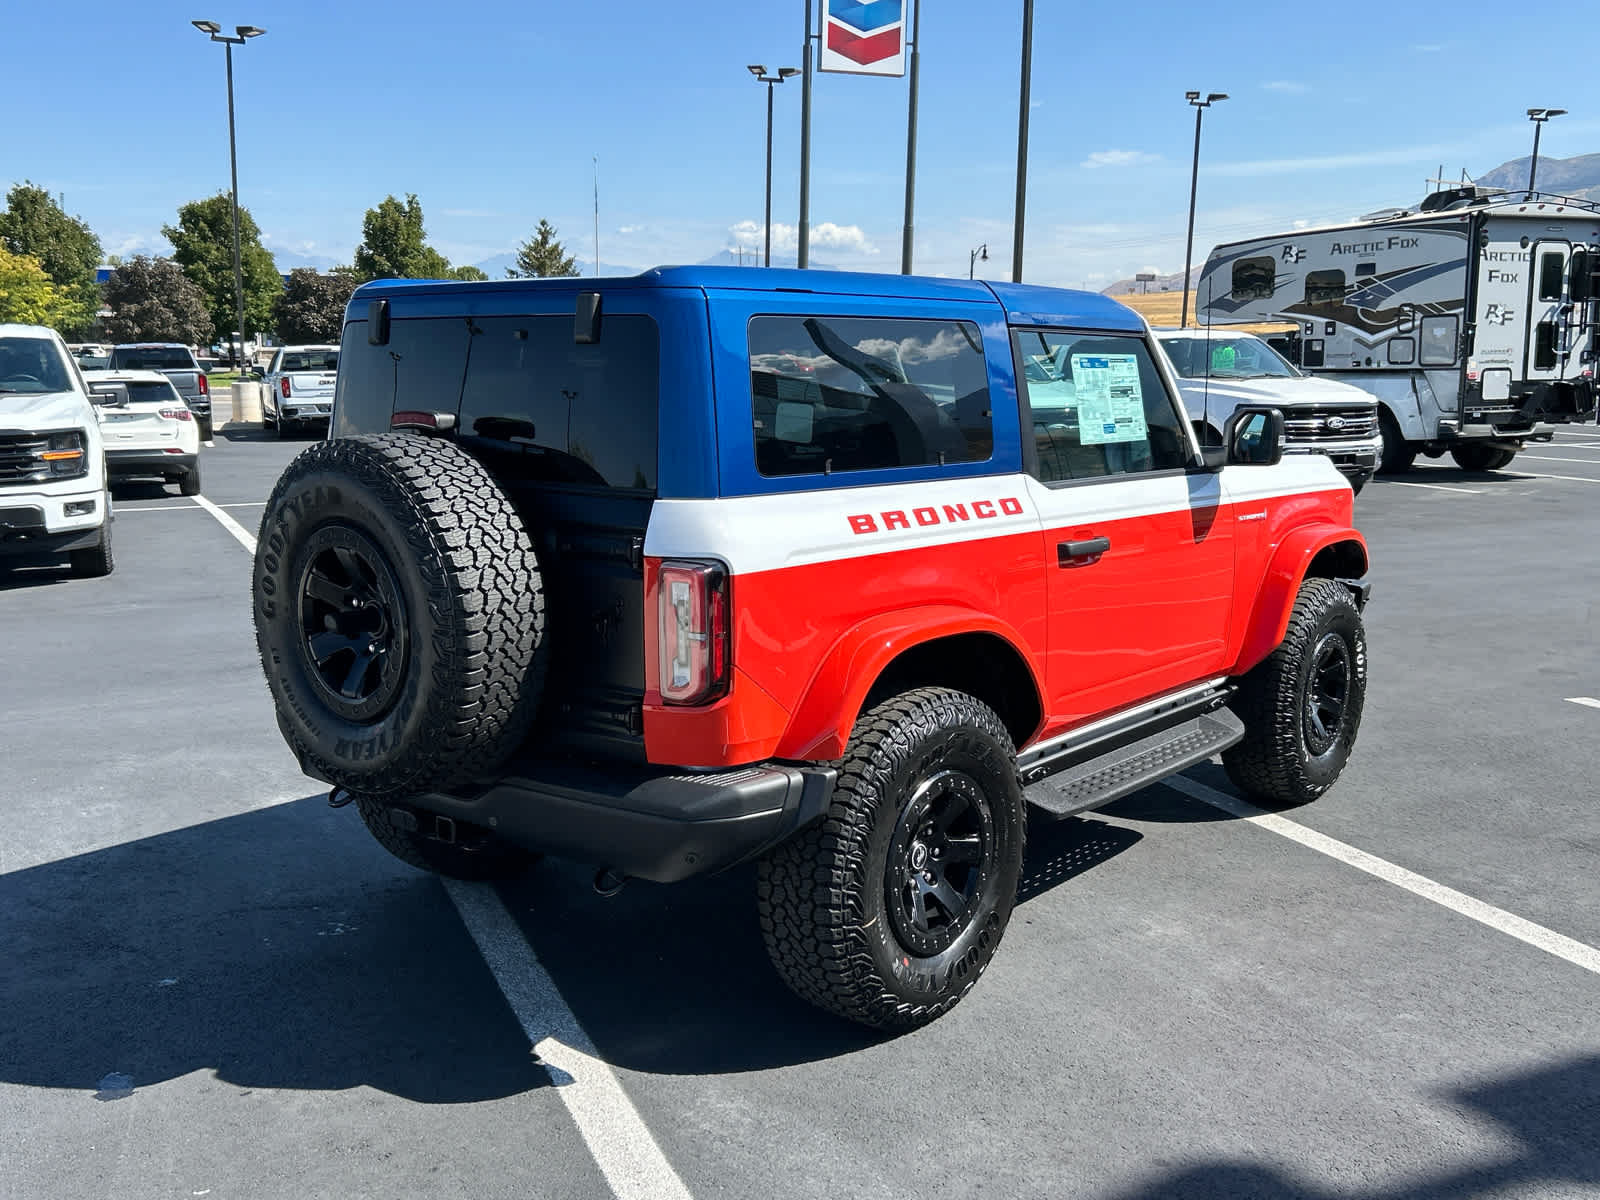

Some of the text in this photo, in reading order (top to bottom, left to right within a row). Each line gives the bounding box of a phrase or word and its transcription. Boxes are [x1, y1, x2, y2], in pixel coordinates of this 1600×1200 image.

[1330, 235, 1420, 256] ARCTIC FOX
[1480, 248, 1531, 262] ARCTIC
[1488, 269, 1519, 283] FOX
[847, 497, 1024, 535] BRONCO
